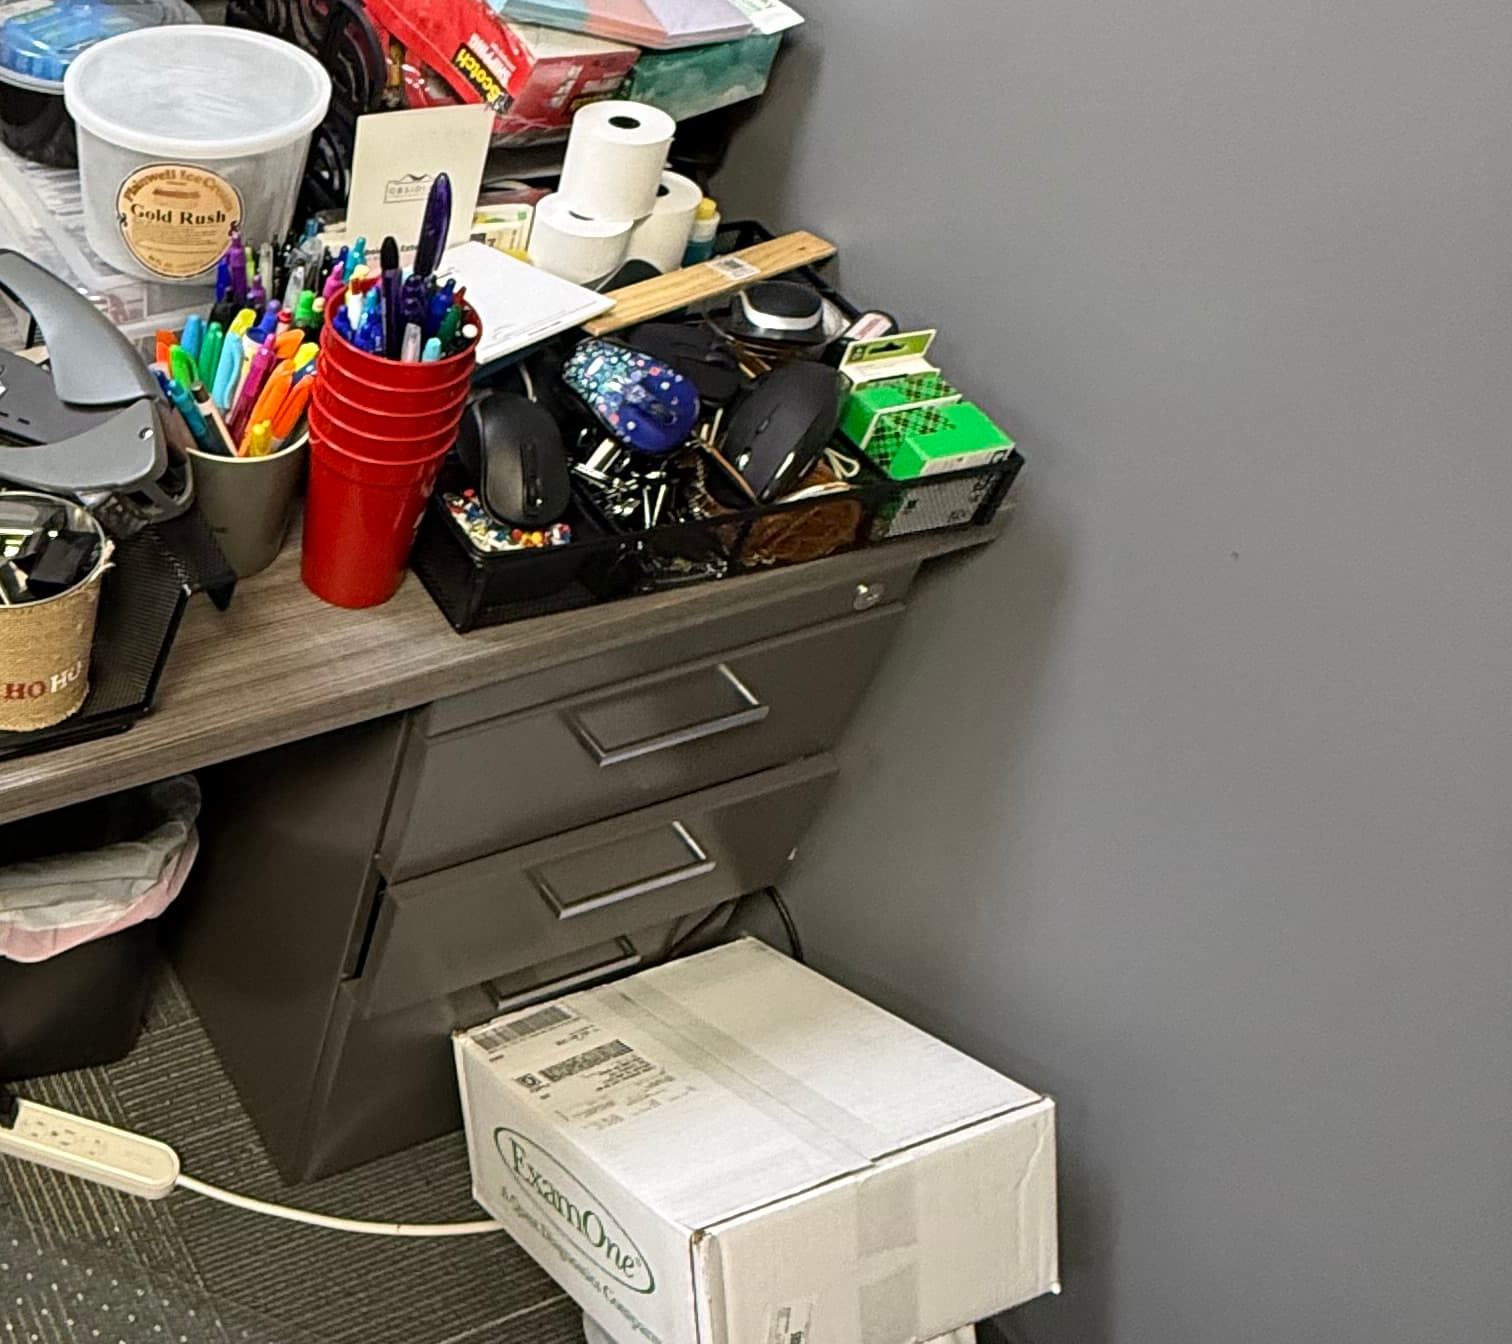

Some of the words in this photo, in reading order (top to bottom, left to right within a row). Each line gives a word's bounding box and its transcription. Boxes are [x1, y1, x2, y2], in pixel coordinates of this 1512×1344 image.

[456, 48, 501, 104] Scotch
[131, 204, 172, 223] Gold
[180, 211, 226, 224] Rush
[4, 681, 46, 700] HO
[510, 1136, 635, 1278] ExamOne
